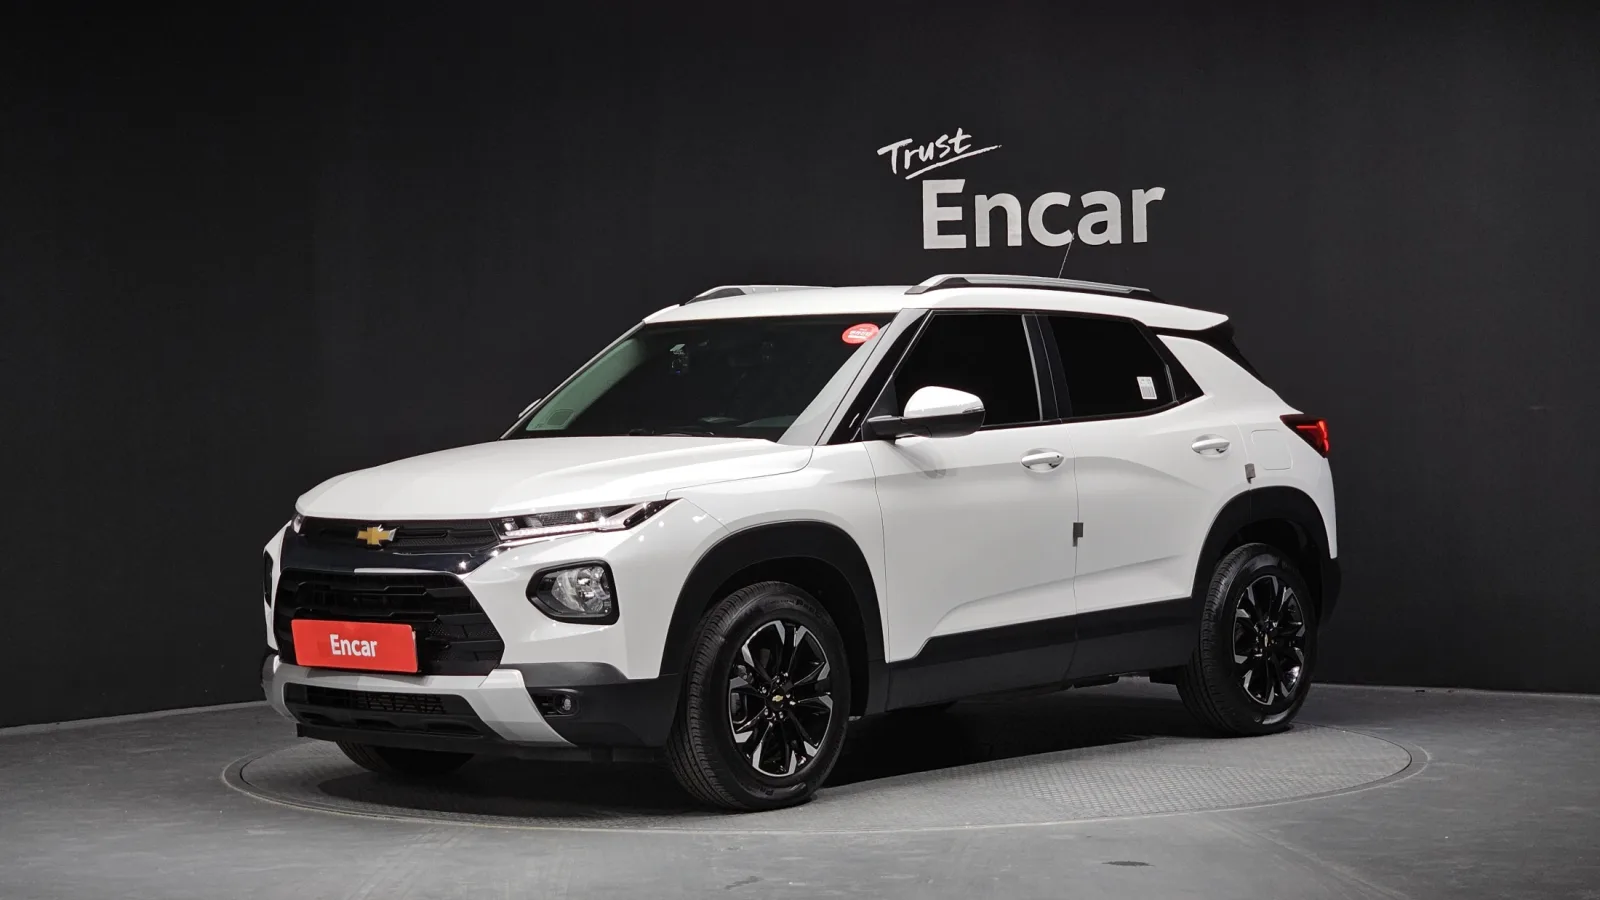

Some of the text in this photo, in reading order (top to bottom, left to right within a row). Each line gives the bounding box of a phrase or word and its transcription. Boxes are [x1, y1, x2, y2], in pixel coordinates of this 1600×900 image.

[877, 128, 972, 174] Trust
[922, 178, 1166, 249] Encar
[329, 633, 378, 657] Encar
